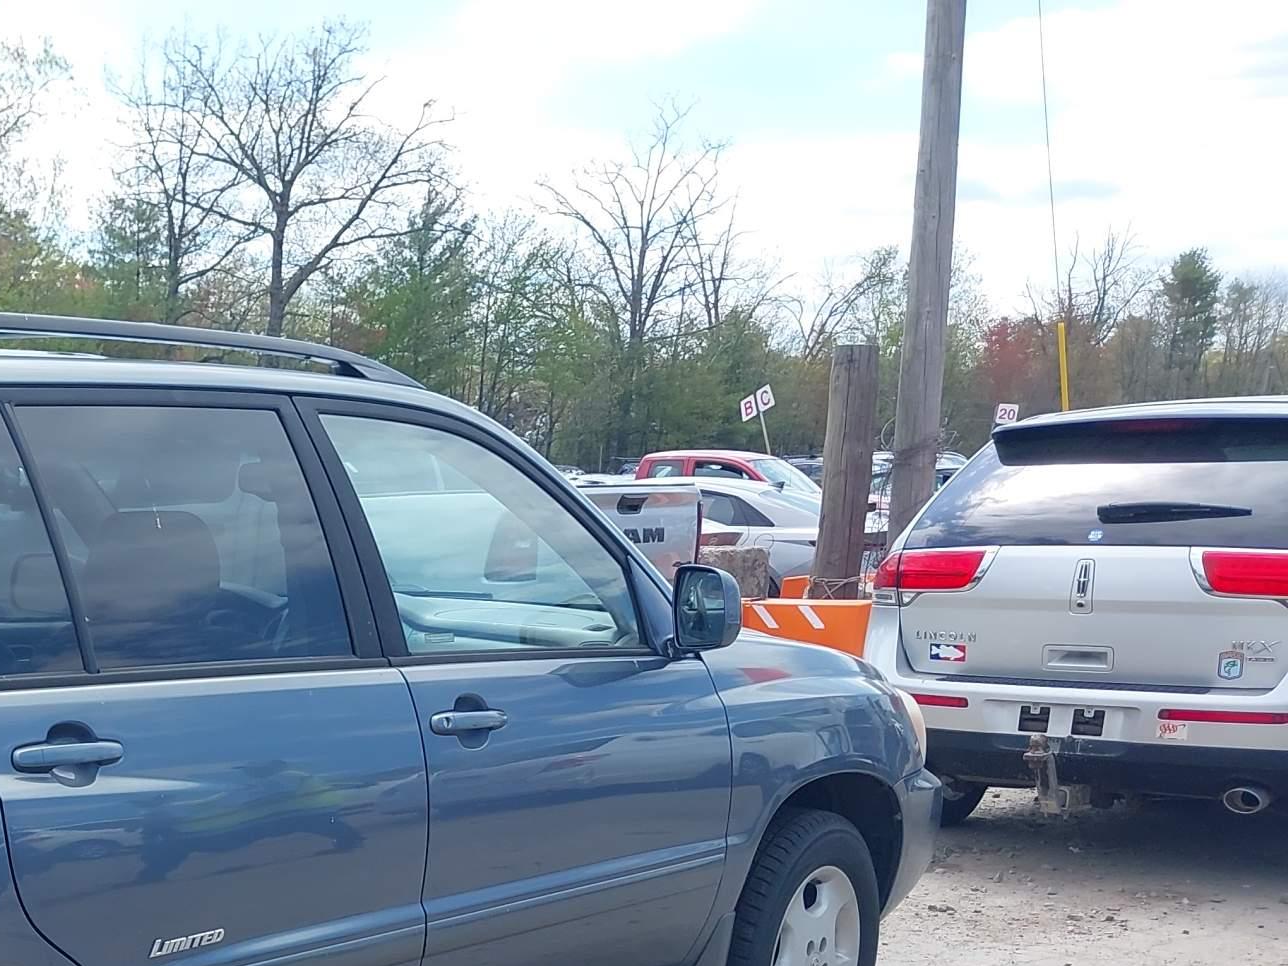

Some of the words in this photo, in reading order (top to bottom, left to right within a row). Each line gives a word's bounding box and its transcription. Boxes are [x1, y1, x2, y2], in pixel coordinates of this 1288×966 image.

[744, 400, 754, 417] B
[760, 389, 771, 406] C
[998, 408, 1016, 421] 20
[623, 527, 665, 544] AM
[915, 630, 977, 642] LINCOLN
